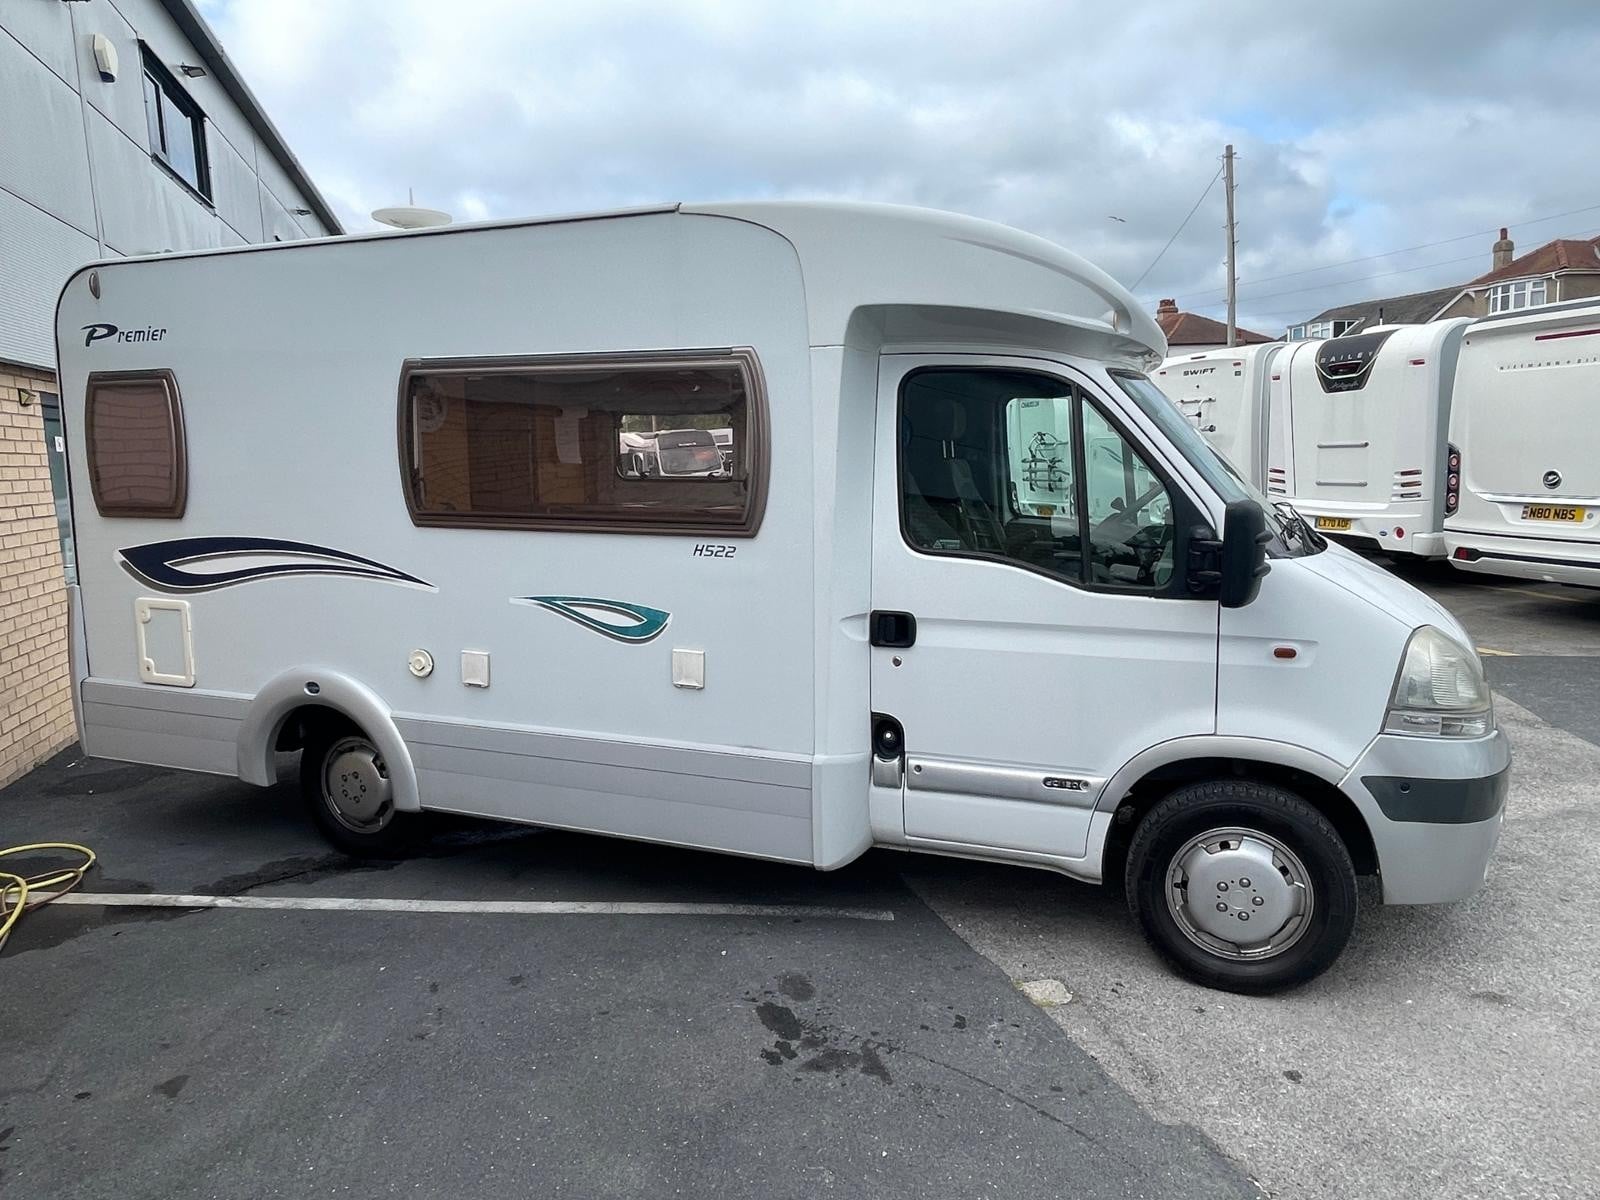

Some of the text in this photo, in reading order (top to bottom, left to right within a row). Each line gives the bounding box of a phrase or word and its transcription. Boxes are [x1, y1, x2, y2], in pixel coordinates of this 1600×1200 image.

[80, 323, 167, 347] Premier
[1320, 352, 1374, 364] BAILEY
[1183, 367, 1216, 376] SWIFT
[1528, 507, 1577, 520] N80 NBS
[693, 544, 737, 558] H522
